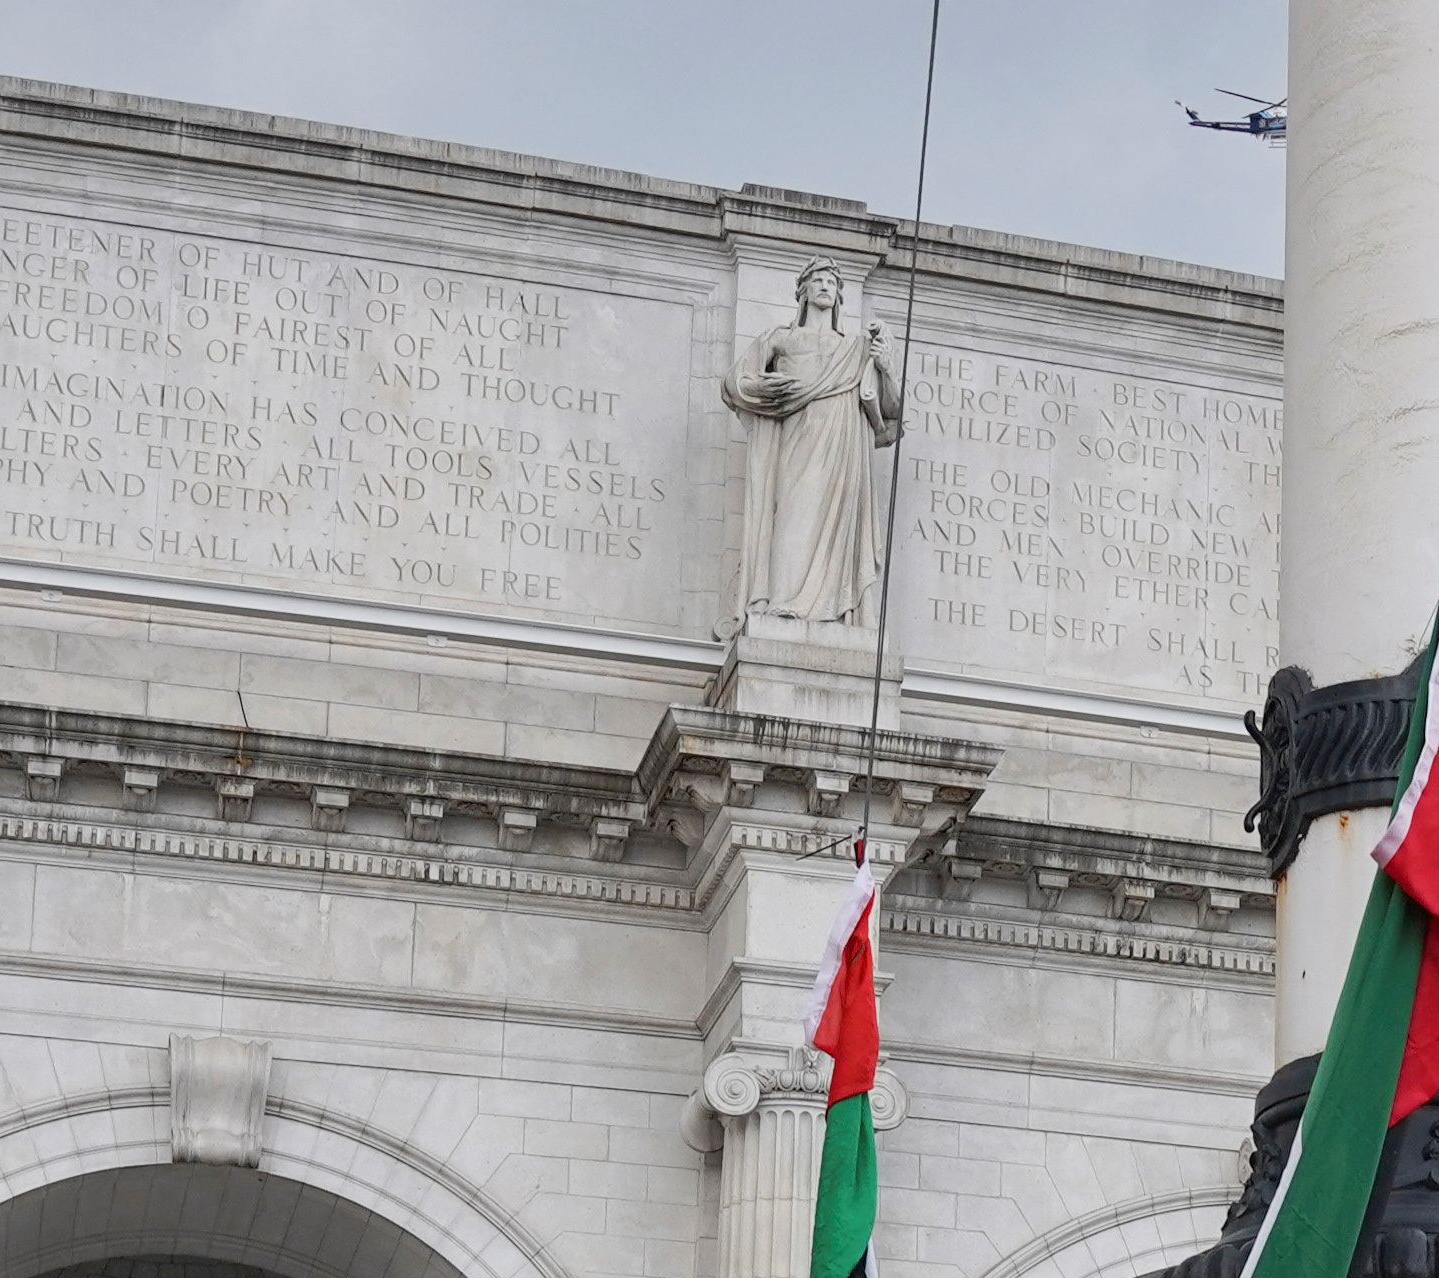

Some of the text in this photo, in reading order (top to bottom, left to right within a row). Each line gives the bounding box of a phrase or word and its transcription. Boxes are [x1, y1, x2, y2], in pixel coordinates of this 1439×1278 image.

[116, 265, 159, 292] OF
[181, 274, 250, 306] LIFE
[275, 287, 342, 318] OUT
[365, 300, 406, 326] OF
[429, 308, 570, 350] NAUGHT
[178, 243, 221, 269] OF
[242, 251, 309, 284] HUT
[327, 263, 399, 296] AND
[423, 277, 464, 304] OF
[484, 285, 570, 321] HALL
[187, 305, 209, 330] O
[234, 313, 373, 353] FAIREST
[394, 334, 435, 361] OF
[453, 343, 514, 373] ALL
[205, 339, 248, 368] OF
[270, 347, 349, 380] TIME
[366, 362, 440, 392] AND
[461, 372, 621, 418] THOUGHT
[915, 352, 973, 382] THE
[994, 364, 1077, 399] FARM
[1112, 383, 1187, 414] BEST
[1, 363, 230, 415] IMAGINATION
[251, 397, 318, 427] HAS
[341, 407, 540, 455] CONCEIVED
[561, 437, 622, 466] ALL
[1041, 401, 1079, 425] OF
[1099, 409, 1250, 453] NATIONAL
[17, 399, 92, 428] AND
[114, 410, 264, 451] LETTERS
[302, 434, 364, 464] ALL
[385, 443, 493, 480] TOOLS
[514, 461, 667, 503] VESSELS
[1077, 435, 1207, 474] SOCIETY
[70, 468, 147, 498] AND
[170, 478, 299, 518] POETRY
[324, 500, 399, 529] AND
[418, 511, 480, 539] ALL
[500, 520, 643, 561] POLITIES
[146, 445, 257, 481] EVERY
[269, 462, 339, 491] ART
[354, 472, 425, 501] AND
[448, 482, 557, 519] TRADE
[591, 502, 653, 531] ALL
[909, 457, 968, 487] THE
[990, 470, 1050, 498] OLD
[1072, 482, 1235, 527] MECHANIC
[4, 510, 116, 548] TRUTH
[137, 526, 248, 564] SHALL
[268, 542, 367, 578] MAKE
[391, 557, 458, 588] YOU
[480, 568, 562, 600] FREE
[909, 518, 976, 547] AND
[999, 529, 1064, 558] MEN
[1101, 544, 1251, 588] OVERRIDE
[930, 490, 1256, 558] FORCES BUILD NEW
[934, 550, 993, 579] THE
[1012, 560, 1092, 593] VERY
[1114, 576, 1211, 611] ETHER
[929, 598, 986, 627] THE
[1008, 608, 1127, 648] DESERT
[1147, 628, 1245, 664] SHALL
[1175, 665, 1212, 688] AS
